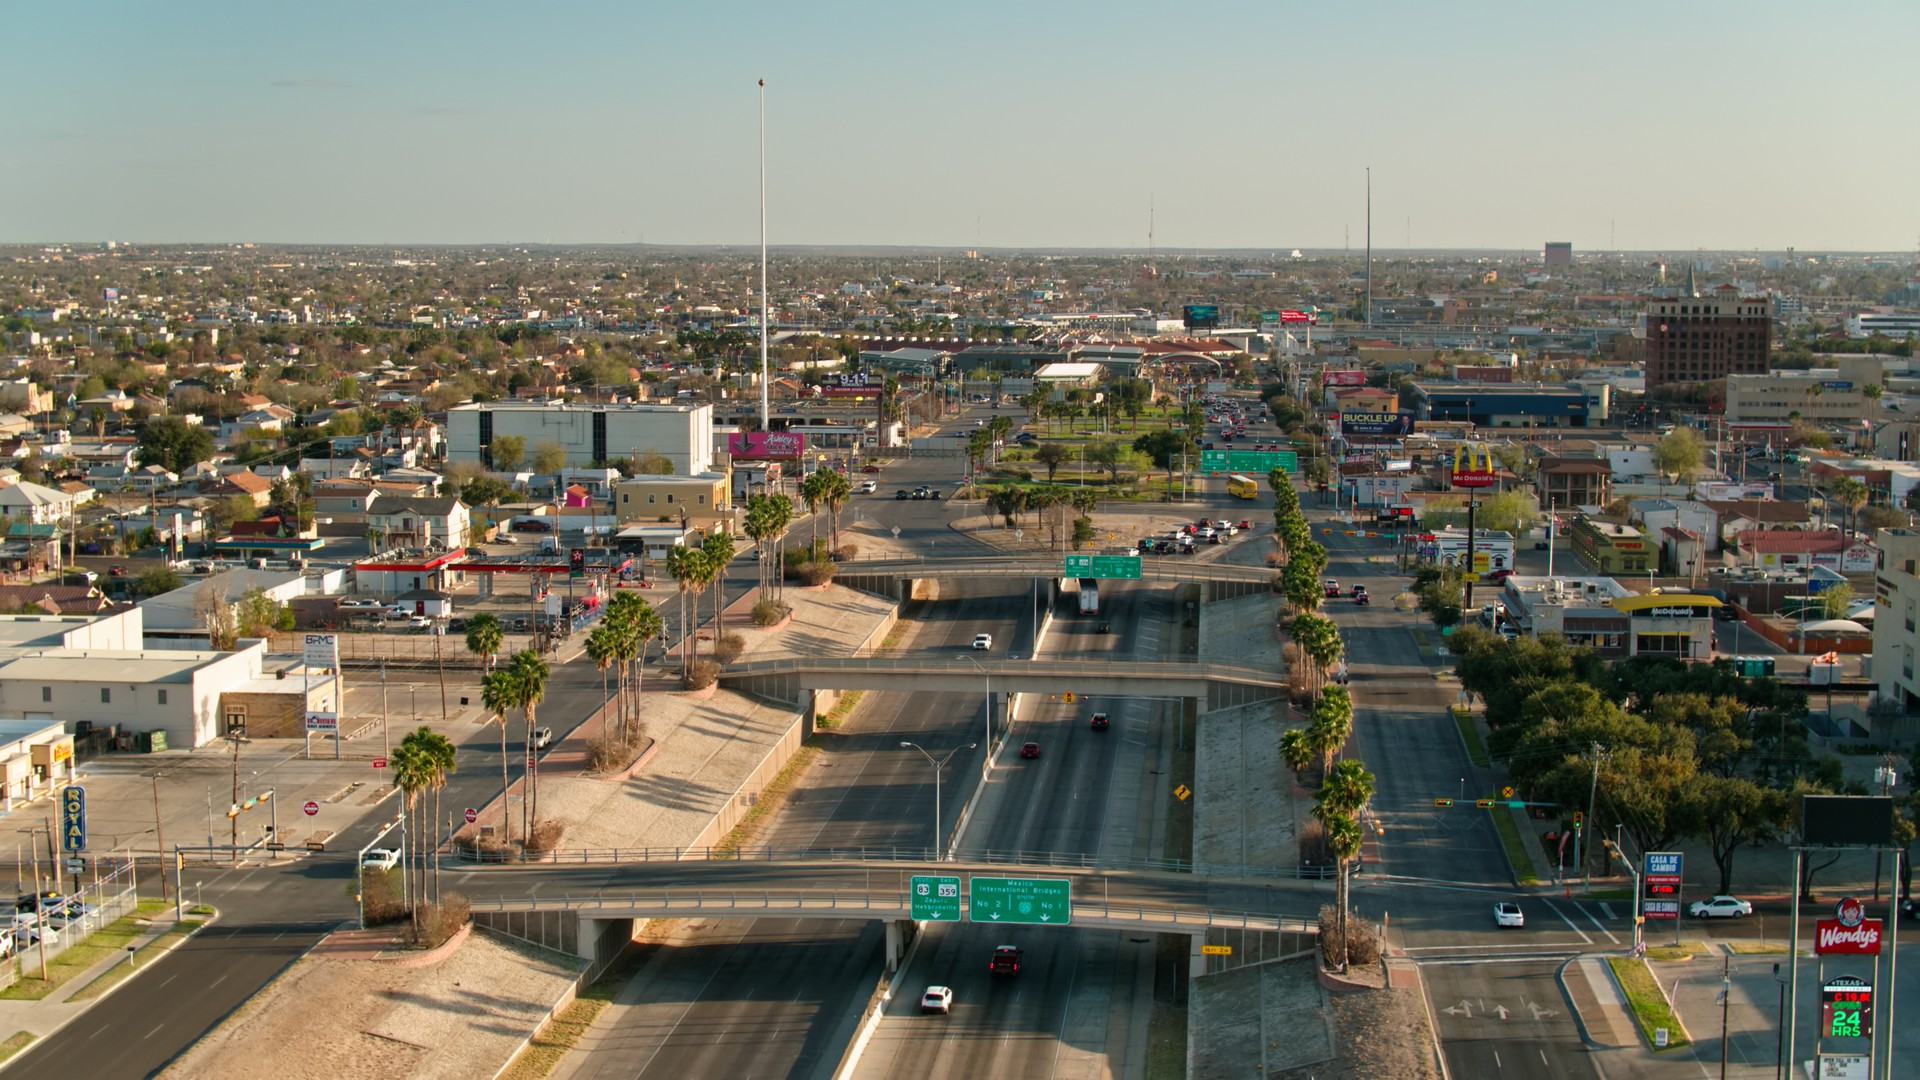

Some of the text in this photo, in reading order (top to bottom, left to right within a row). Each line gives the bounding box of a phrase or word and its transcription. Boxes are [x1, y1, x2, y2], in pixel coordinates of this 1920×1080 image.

[840, 374, 868, 384] 9-1-1
[1344, 414, 1382, 422] BUCKLE
[763, 433, 798, 445] Ashley's
[67, 789, 81, 848] ROYAL
[1820, 925, 1878, 948] Wendy's
[1834, 993, 1842, 1001] C
[1832, 1011, 1860, 1026] 24
[1832, 1027, 1861, 1036] HRS
